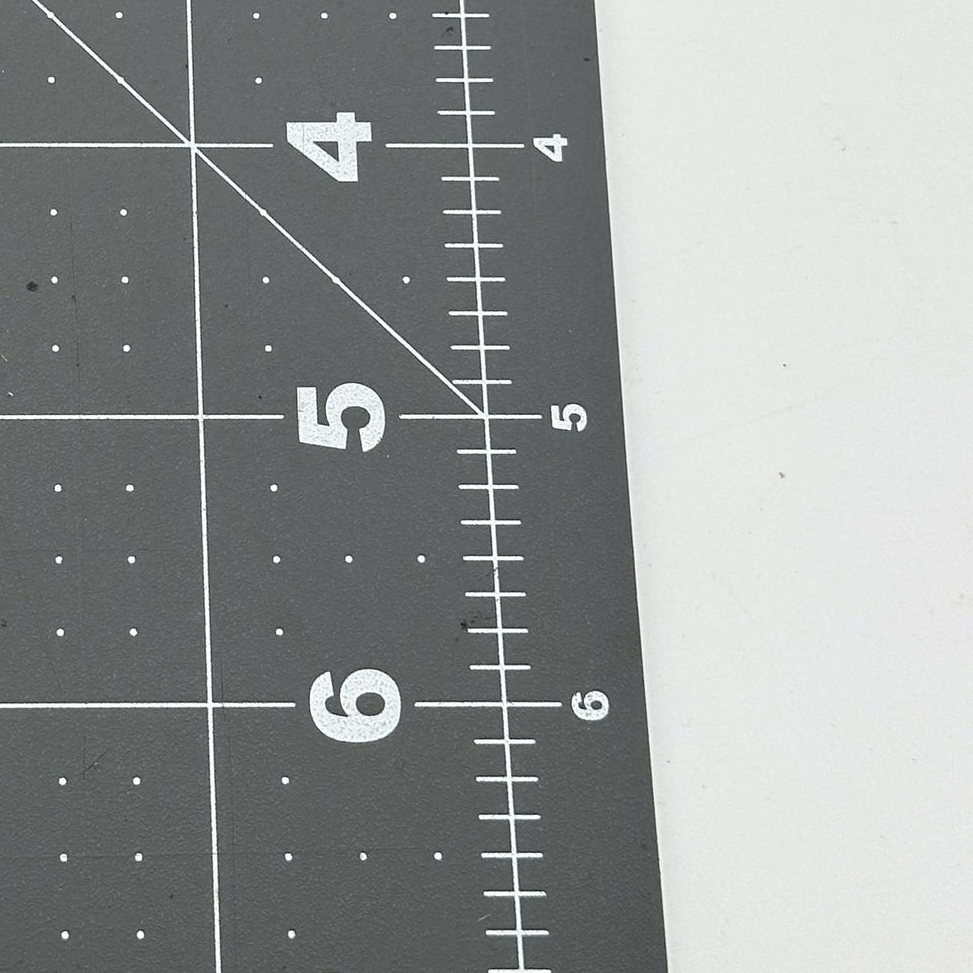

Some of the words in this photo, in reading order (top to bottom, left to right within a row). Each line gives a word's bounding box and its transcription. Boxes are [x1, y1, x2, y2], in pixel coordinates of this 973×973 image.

[286, 112, 373, 182] 4
[533, 133, 568, 162] 4
[296, 382, 386, 453] 5
[551, 403, 588, 432] 5
[309, 668, 402, 743] 6
[571, 690, 610, 721] 6
